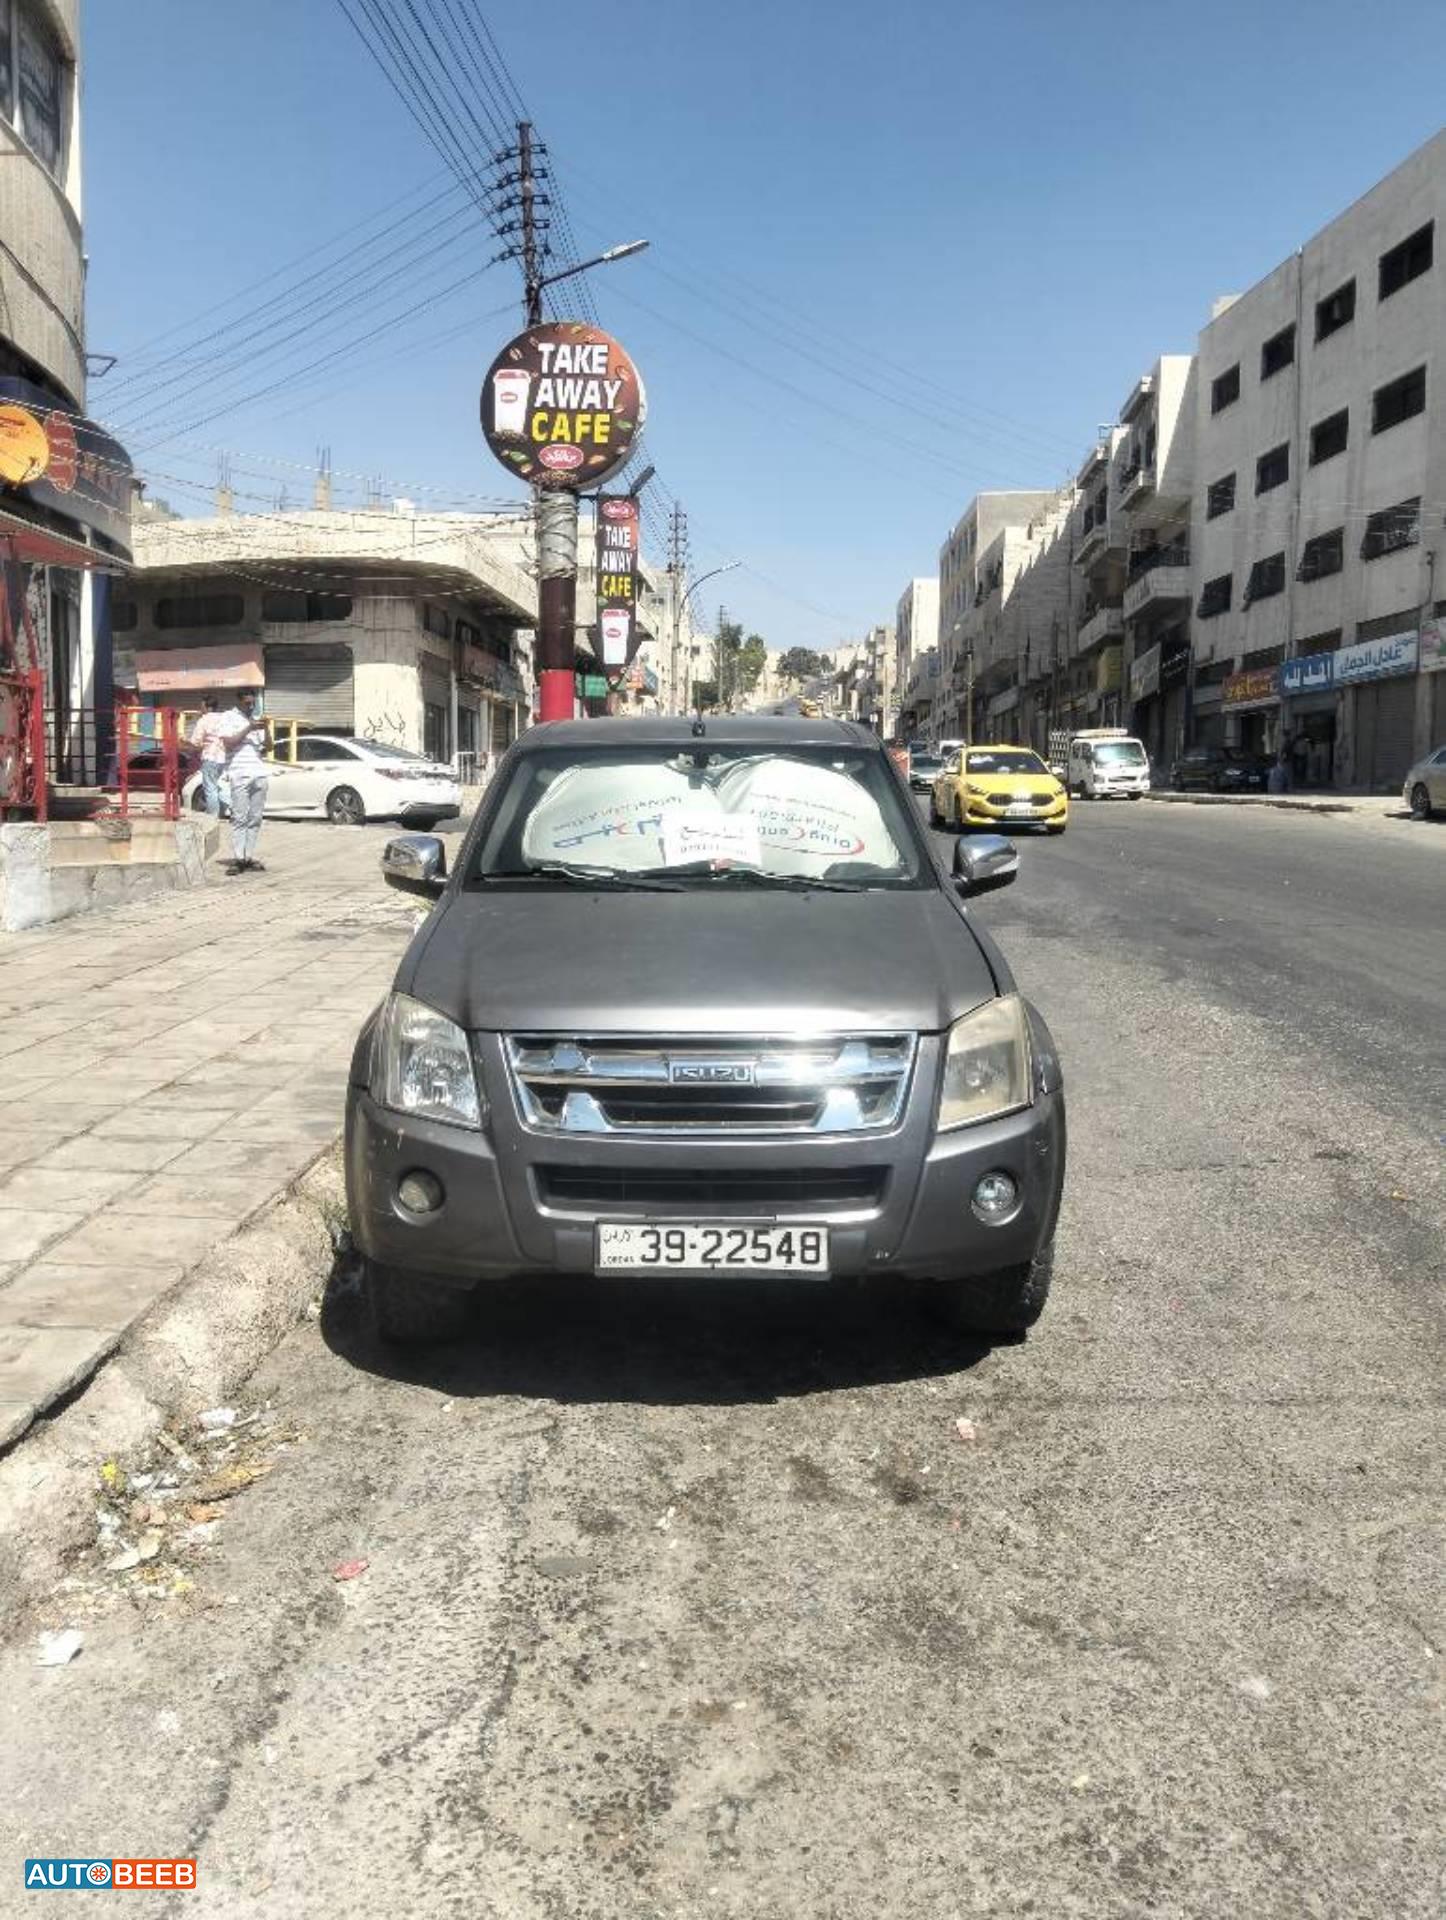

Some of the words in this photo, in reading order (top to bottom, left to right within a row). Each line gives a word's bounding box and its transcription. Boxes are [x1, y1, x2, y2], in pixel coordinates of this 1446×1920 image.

[538, 343, 608, 374] TAKE
[534, 378, 622, 409] AWAY
[531, 411, 610, 443] CAFE
[605, 525, 631, 548] TAKE
[601, 551, 632, 573] AWAY
[601, 575, 631, 597] CAFE
[675, 1067, 750, 1081] ISUZU
[640, 1229, 821, 1265] 39-22548
